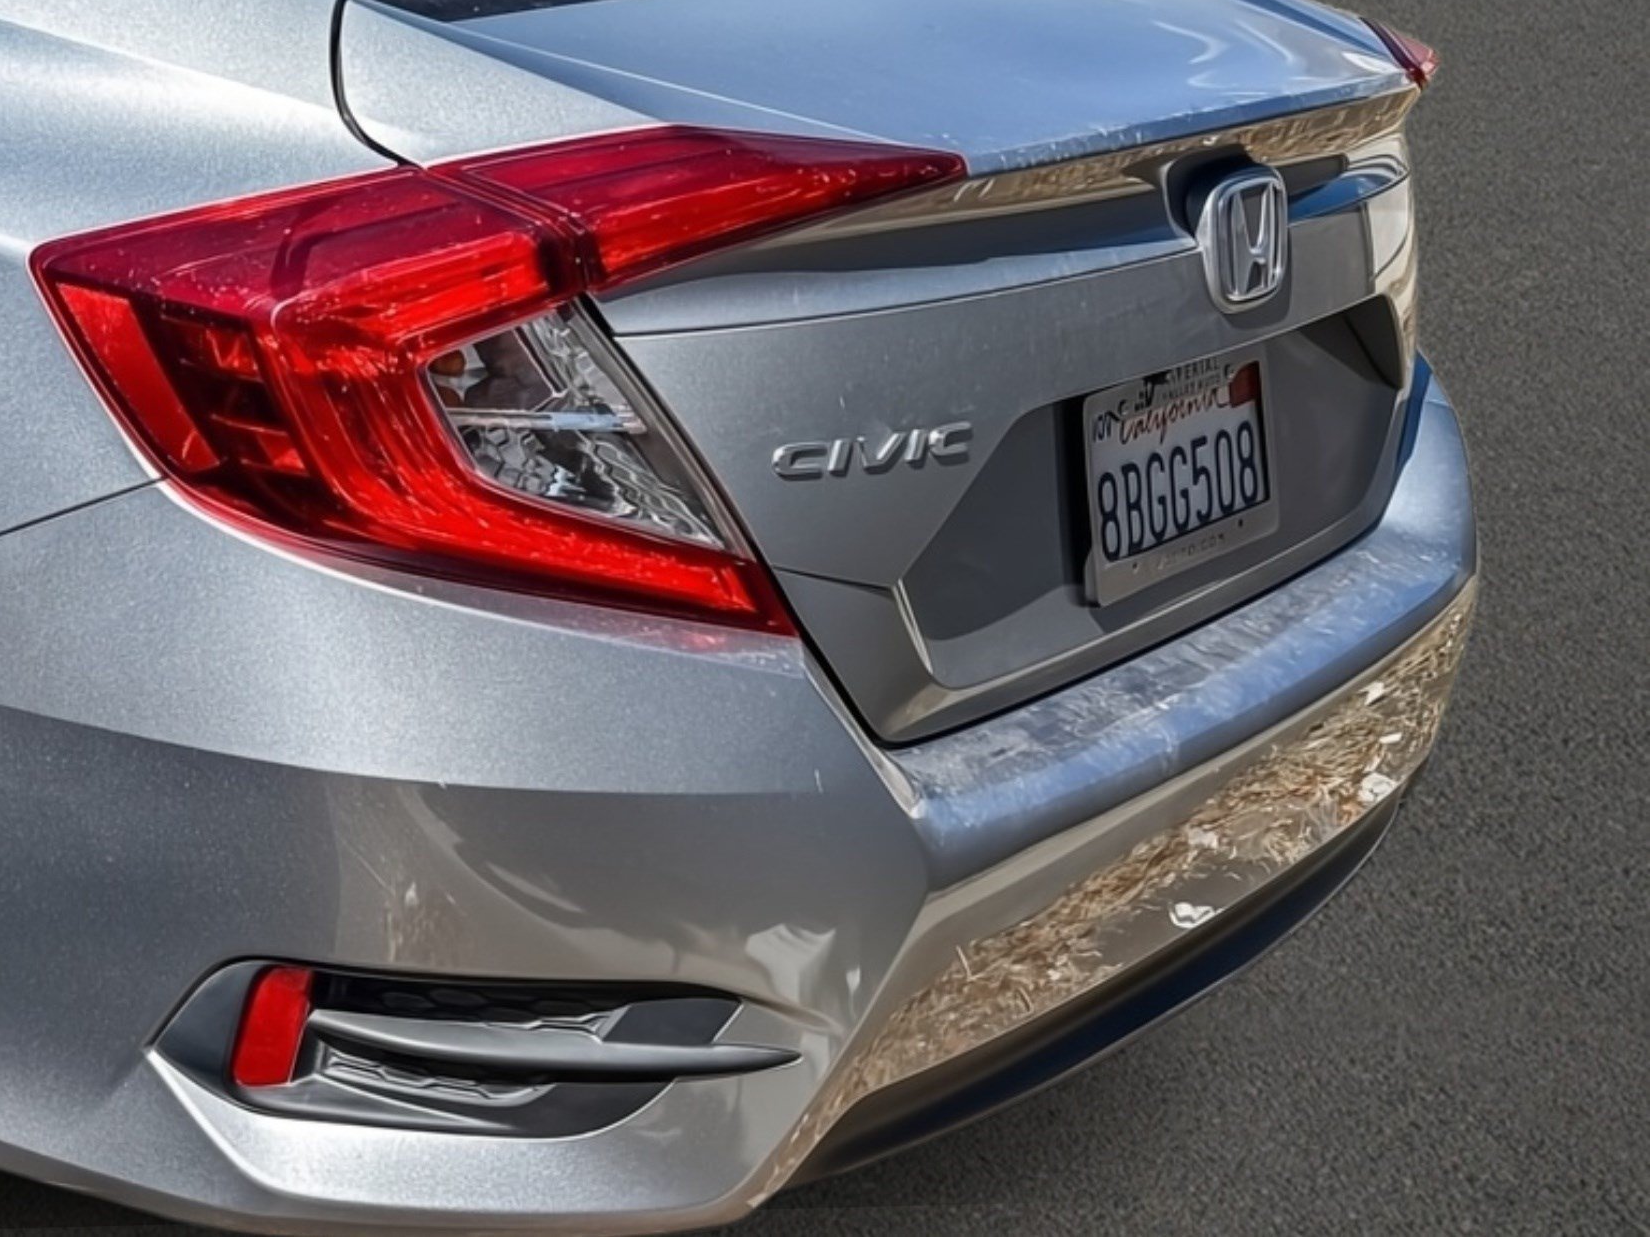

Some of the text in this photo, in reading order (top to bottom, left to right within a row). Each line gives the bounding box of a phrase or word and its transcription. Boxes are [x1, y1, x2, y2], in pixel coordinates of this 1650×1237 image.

[1119, 385, 1228, 446] California
[771, 420, 973, 478] CIVIC
[1097, 420, 1258, 561] 8BGG508
